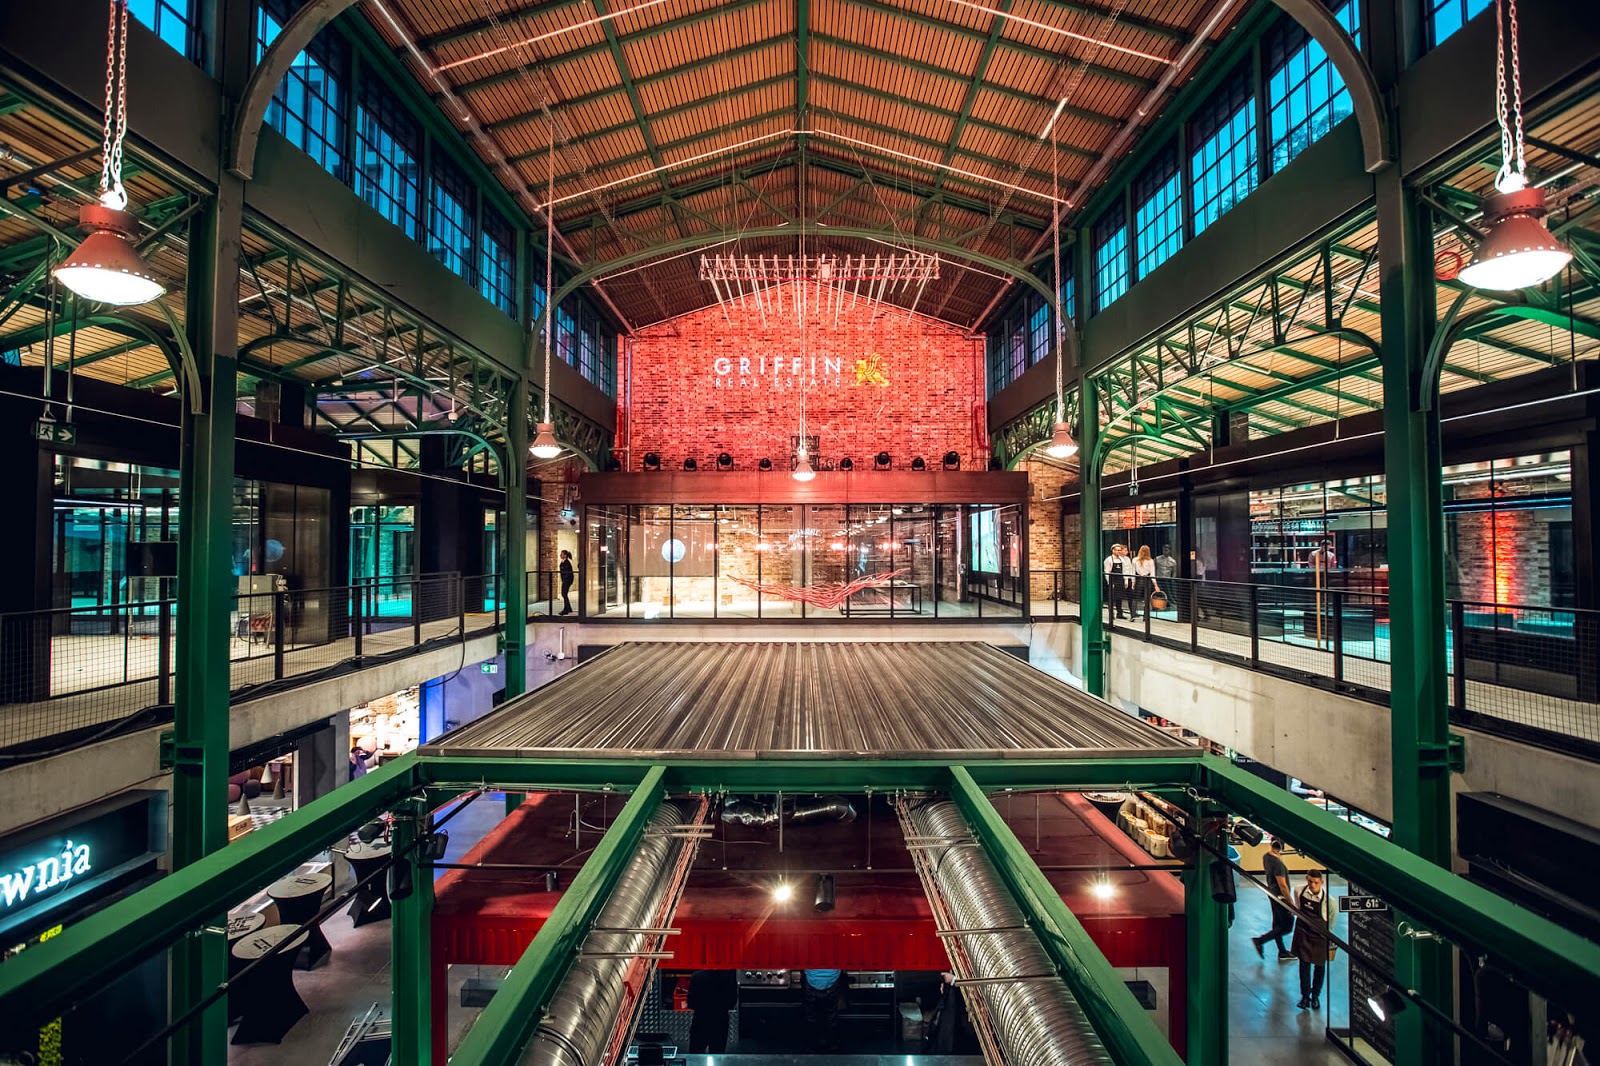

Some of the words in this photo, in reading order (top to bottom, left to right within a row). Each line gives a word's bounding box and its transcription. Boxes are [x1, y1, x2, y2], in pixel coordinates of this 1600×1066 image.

[714, 357, 841, 375] GRIFFIN
[715, 378, 759, 387] REAL
[774, 378, 841, 387] ESTATE
